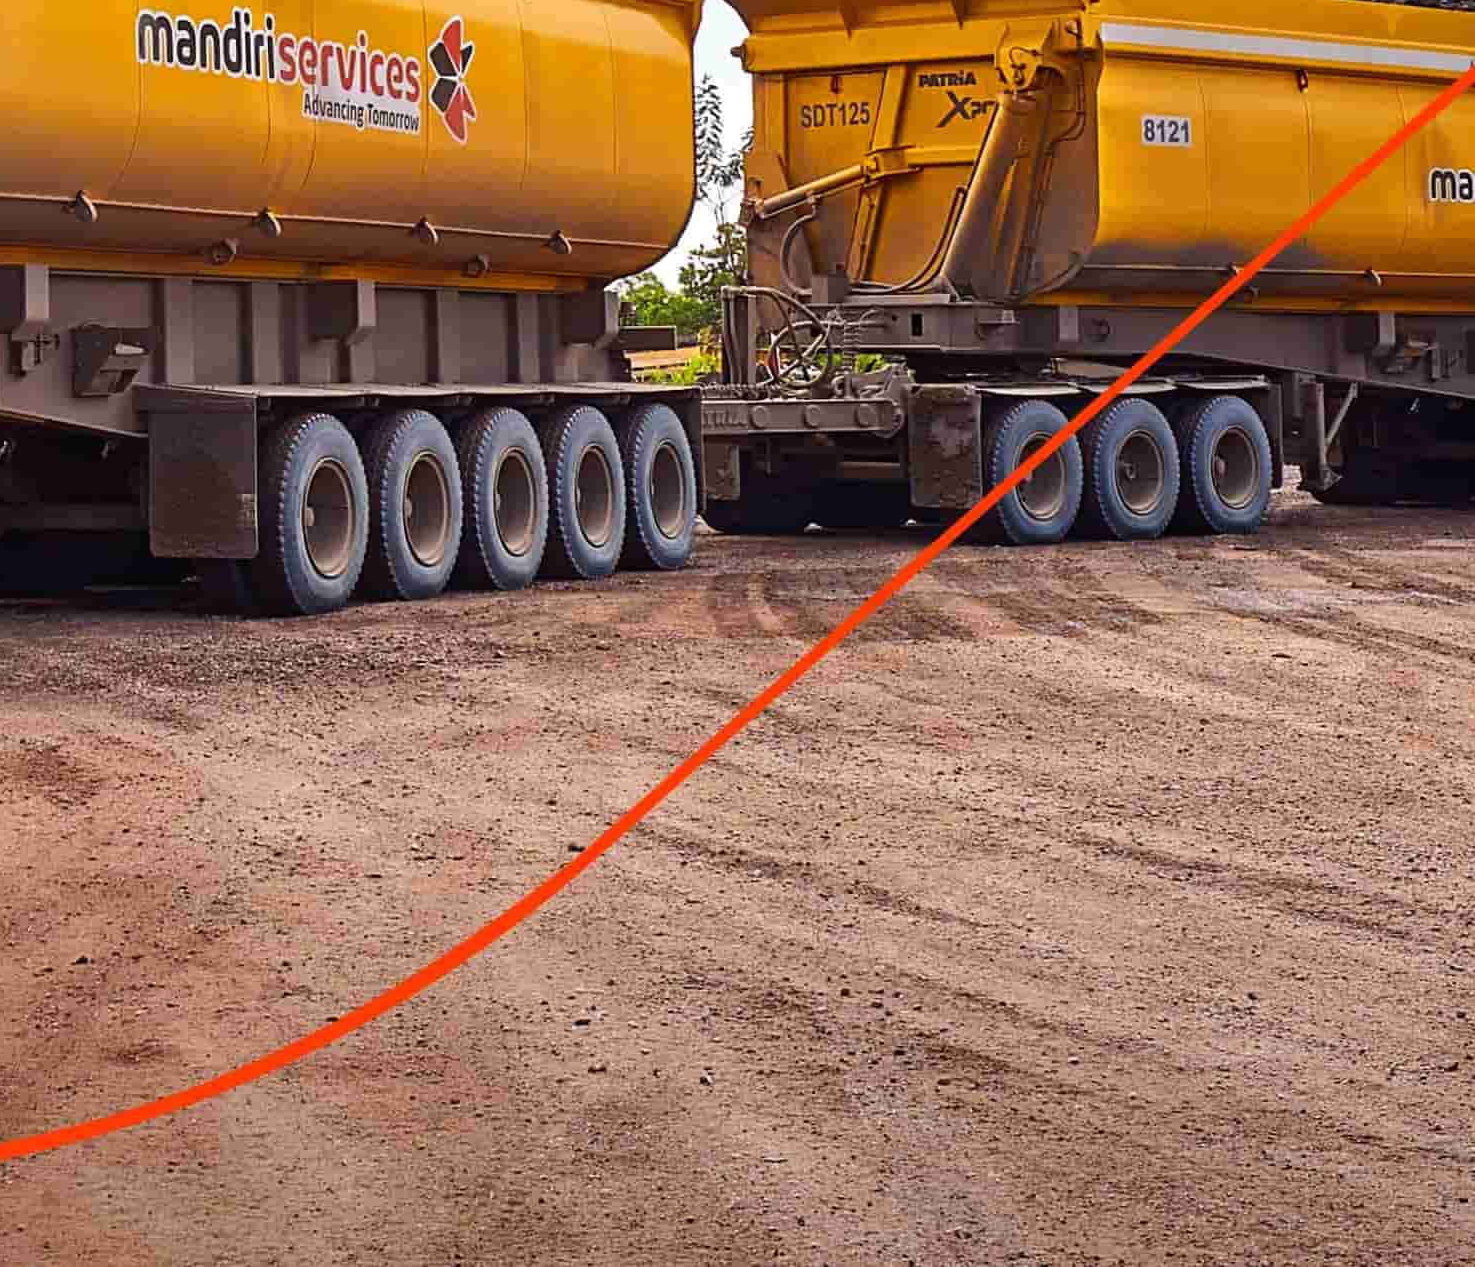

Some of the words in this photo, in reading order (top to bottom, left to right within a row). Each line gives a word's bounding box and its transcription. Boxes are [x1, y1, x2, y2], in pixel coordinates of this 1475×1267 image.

[137, 9, 421, 103] mandiriservices
[303, 93, 365, 127] Advancing
[366, 103, 421, 131] Tomorrow
[801, 101, 871, 129] SDT125
[1143, 118, 1189, 143] 8121
